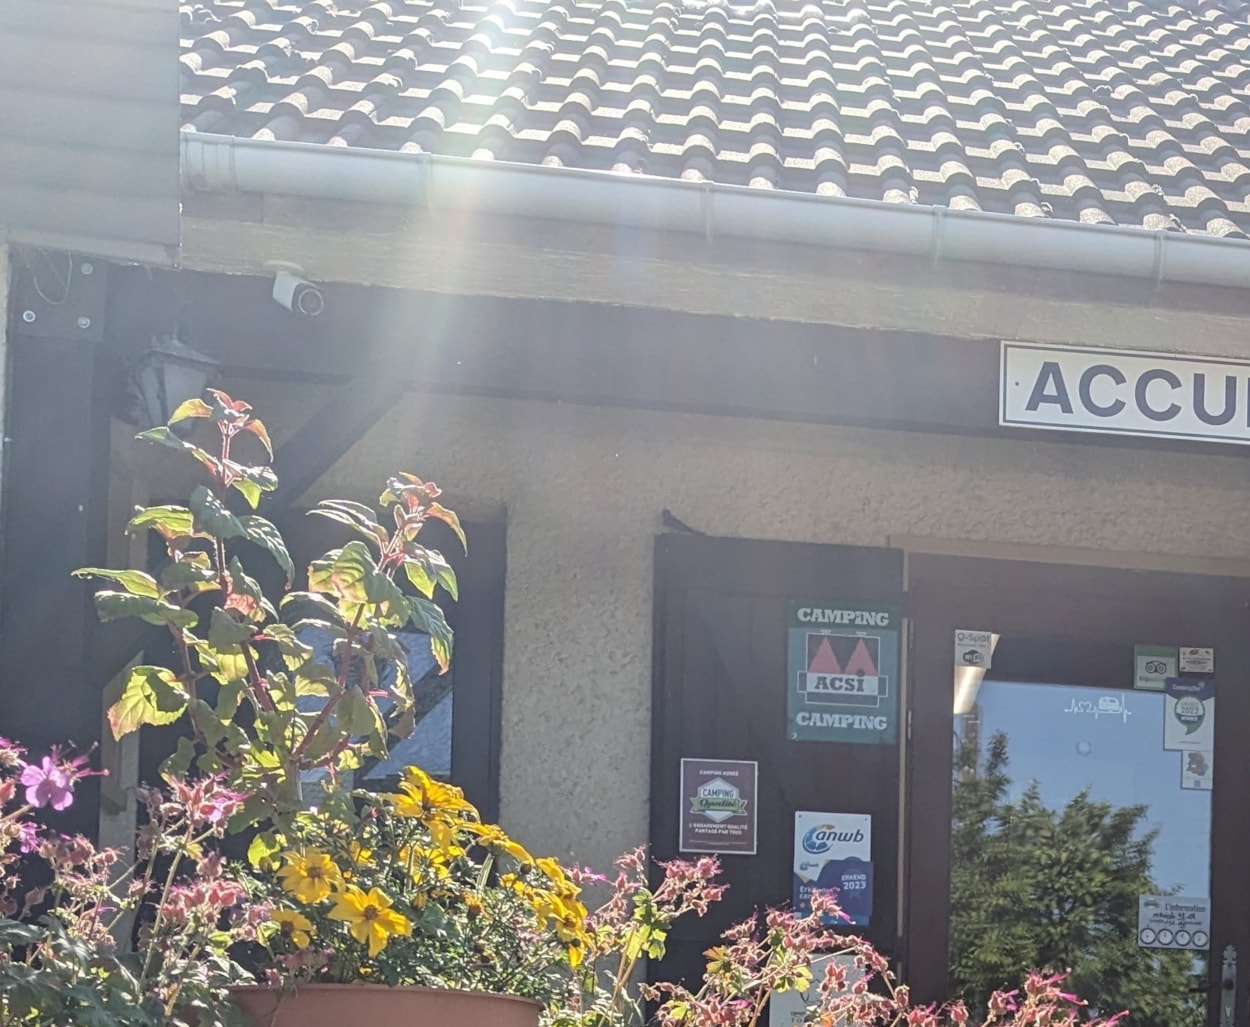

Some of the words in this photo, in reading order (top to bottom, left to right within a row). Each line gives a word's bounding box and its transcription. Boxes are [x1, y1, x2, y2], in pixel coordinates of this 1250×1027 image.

[797, 607, 889, 626] CAMPING
[814, 671, 865, 692] ACSI
[796, 712, 888, 730] CAMPING
[702, 788, 735, 798] CAMPING
[815, 829, 865, 843] anwb
[843, 881, 867, 890] 2023
